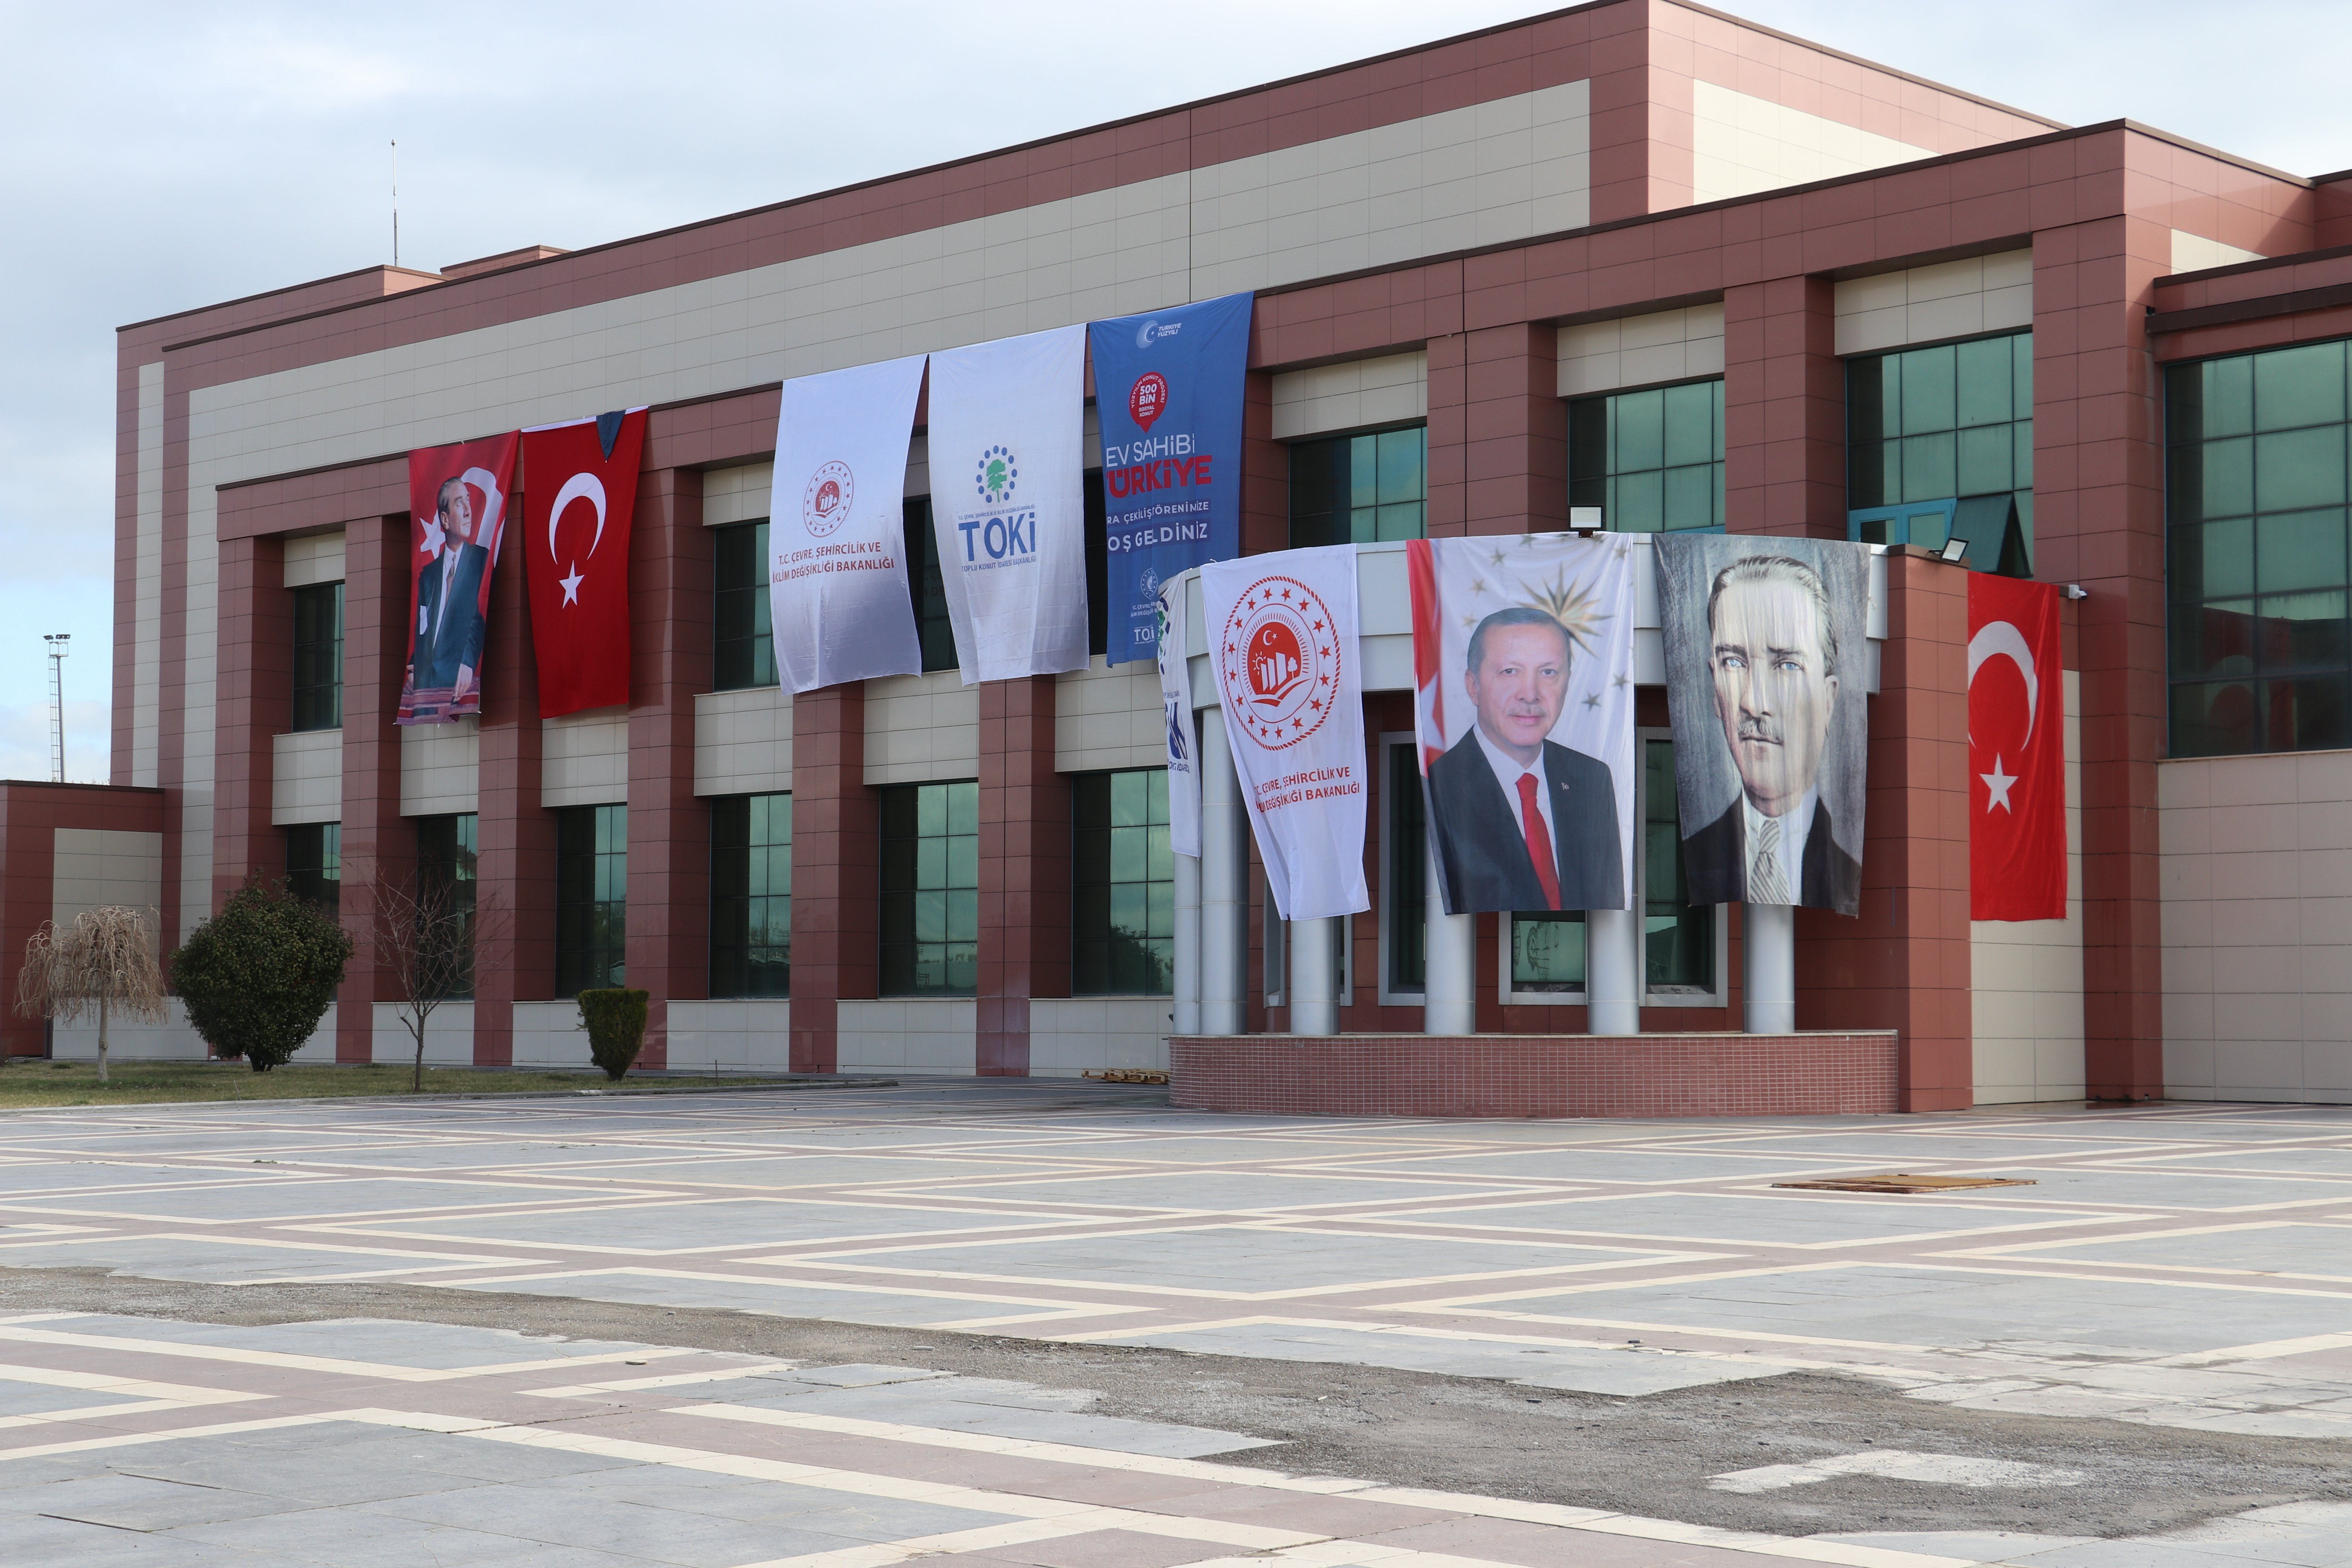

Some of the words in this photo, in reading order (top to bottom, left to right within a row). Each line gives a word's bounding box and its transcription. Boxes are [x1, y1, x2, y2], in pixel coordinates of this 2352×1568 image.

[1140, 383, 1157, 395] 500
[1106, 444, 1129, 468] EV
[1107, 515, 1120, 524] RA
[1123, 507, 1152, 524] ÇEKİLİŞ
[779, 554, 789, 565] T.C.
[791, 549, 814, 565] ÇEVRE,
[815, 541, 866, 560] ŞEHİRCİLİK
[867, 542, 880, 553] VE
[1108, 534, 1131, 553] OŞ
[773, 569, 790, 584] İKLİM
[791, 559, 834, 579] DEĞİŞİKLİĞİ
[837, 556, 894, 572] BAKANLIĞI
[998, 558, 1013, 568] İDARESİ
[1013, 555, 1036, 566] BAŞKANLIĞI
[1262, 779, 1281, 796] ÇEVRE,
[1283, 767, 1335, 789] ŞEHİRCİLİK
[1336, 767, 1350, 778] VE
[1305, 781, 1359, 800] BAKANLIĞI
